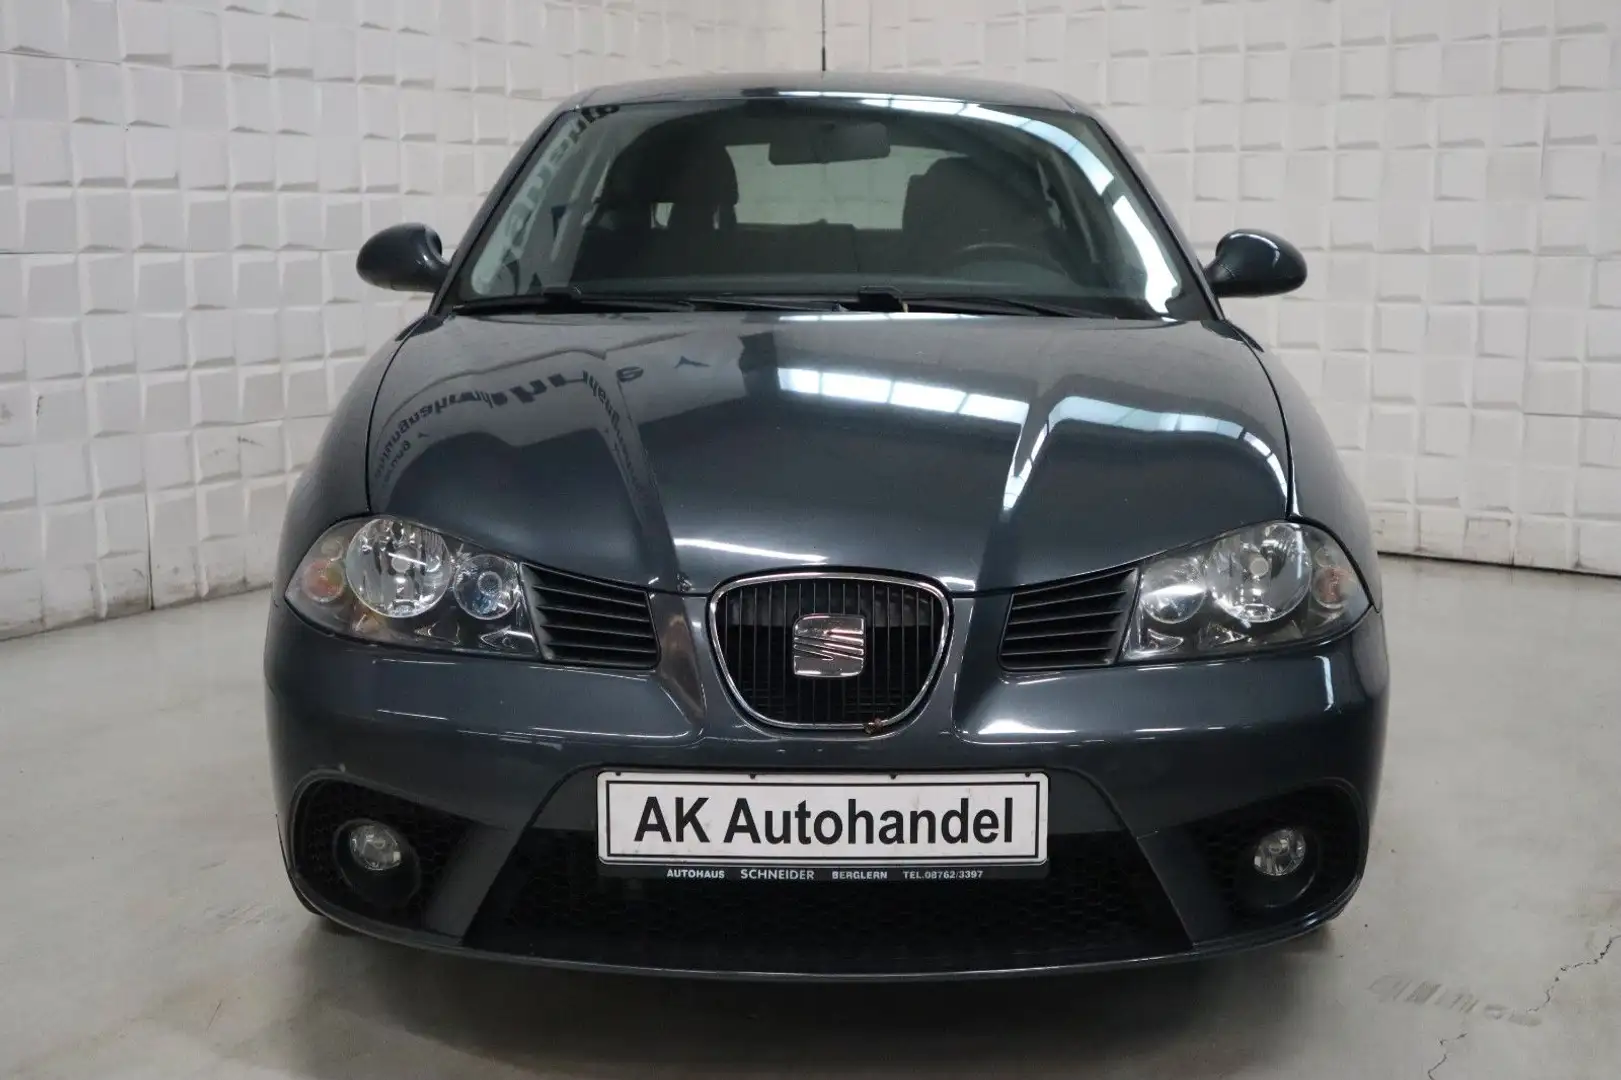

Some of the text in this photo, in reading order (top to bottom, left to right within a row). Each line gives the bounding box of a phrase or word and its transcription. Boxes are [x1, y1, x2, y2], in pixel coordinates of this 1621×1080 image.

[633, 796, 1013, 844] AK Autohandel
[666, 868, 726, 880] AUTOHAUS
[740, 868, 816, 881] SCHNEIDER
[831, 869, 889, 880] BERGLERN
